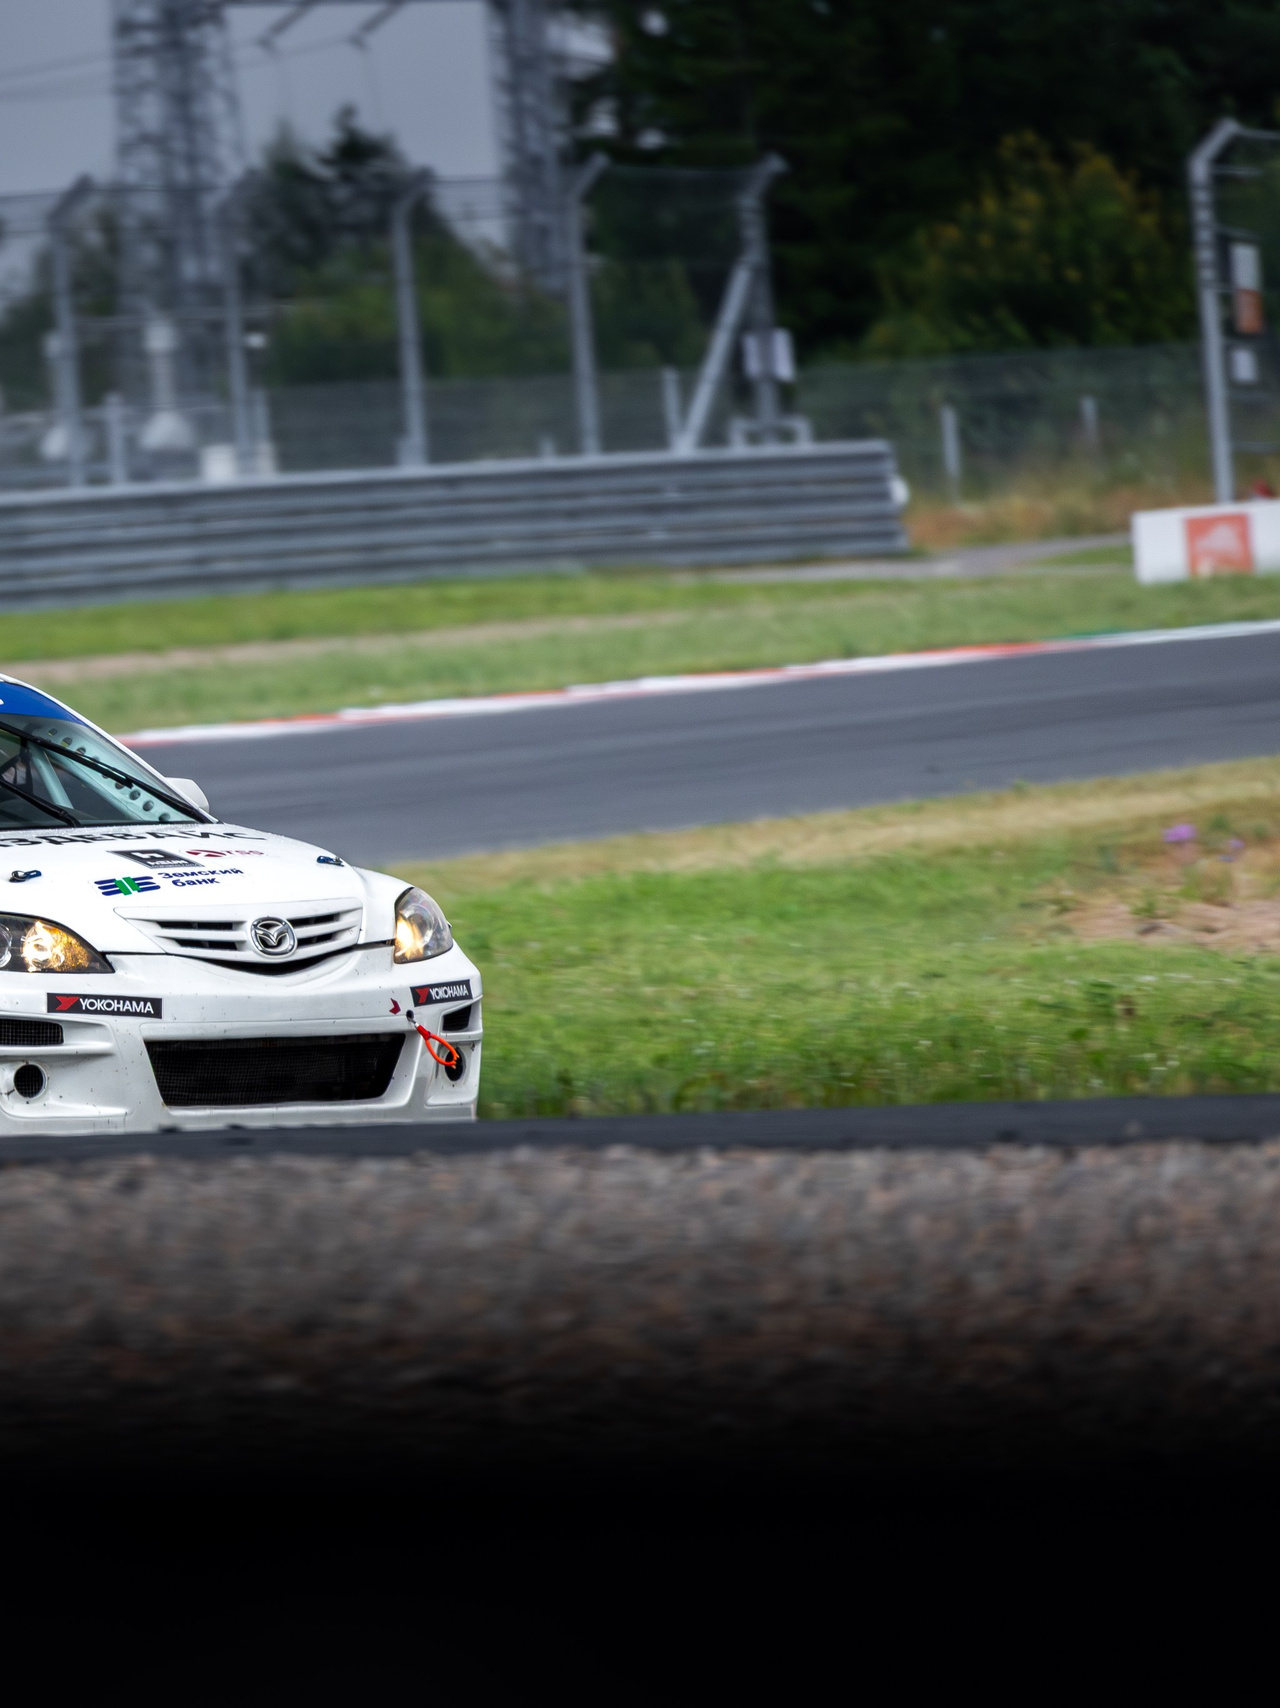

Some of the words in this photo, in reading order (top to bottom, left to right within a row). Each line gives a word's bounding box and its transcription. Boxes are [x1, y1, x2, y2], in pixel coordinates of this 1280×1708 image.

[157, 868, 244, 879] Земский
[172, 878, 220, 887] банк
[429, 984, 469, 1000] YOKOHAMA
[80, 998, 154, 1014] YOKOHAMA
